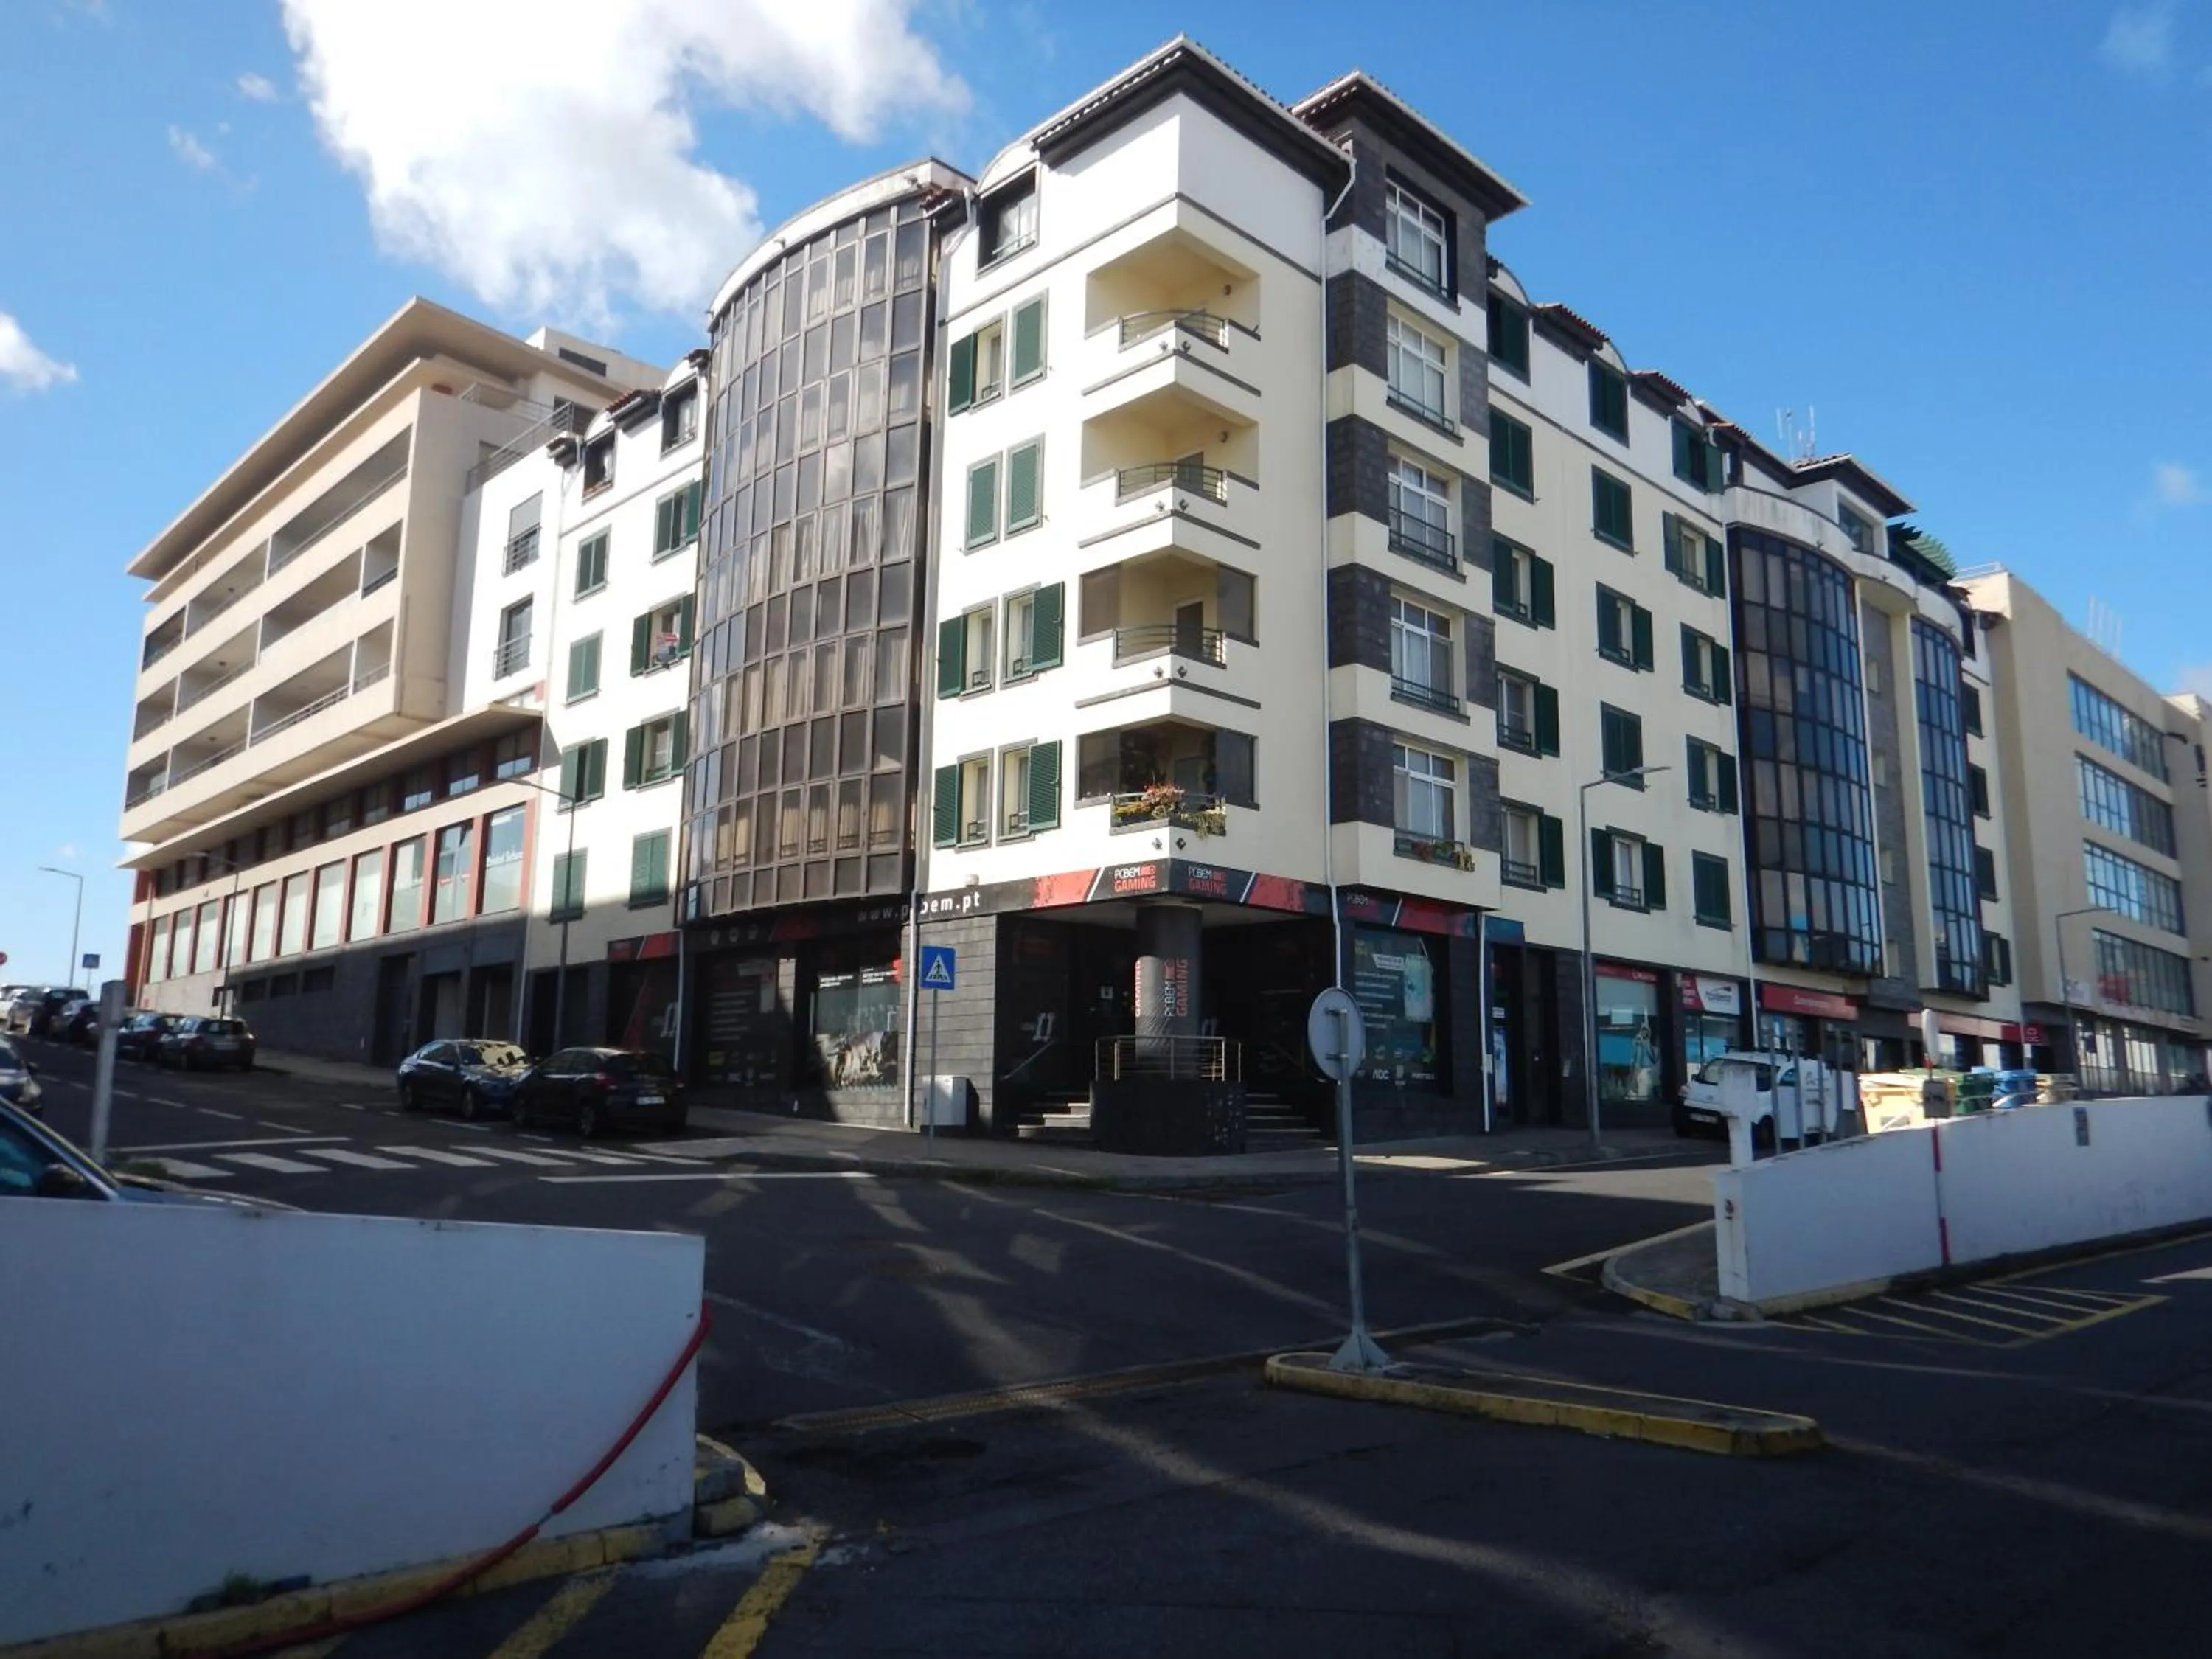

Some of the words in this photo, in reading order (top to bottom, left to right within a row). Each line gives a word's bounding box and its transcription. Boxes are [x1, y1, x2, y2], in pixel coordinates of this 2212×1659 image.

[1114, 875, 1156, 892] GAMING
[1189, 877, 1228, 896] GAMING
[858, 891, 980, 921] www.pbem.pt
[1176, 959, 1188, 1017] GAMING
